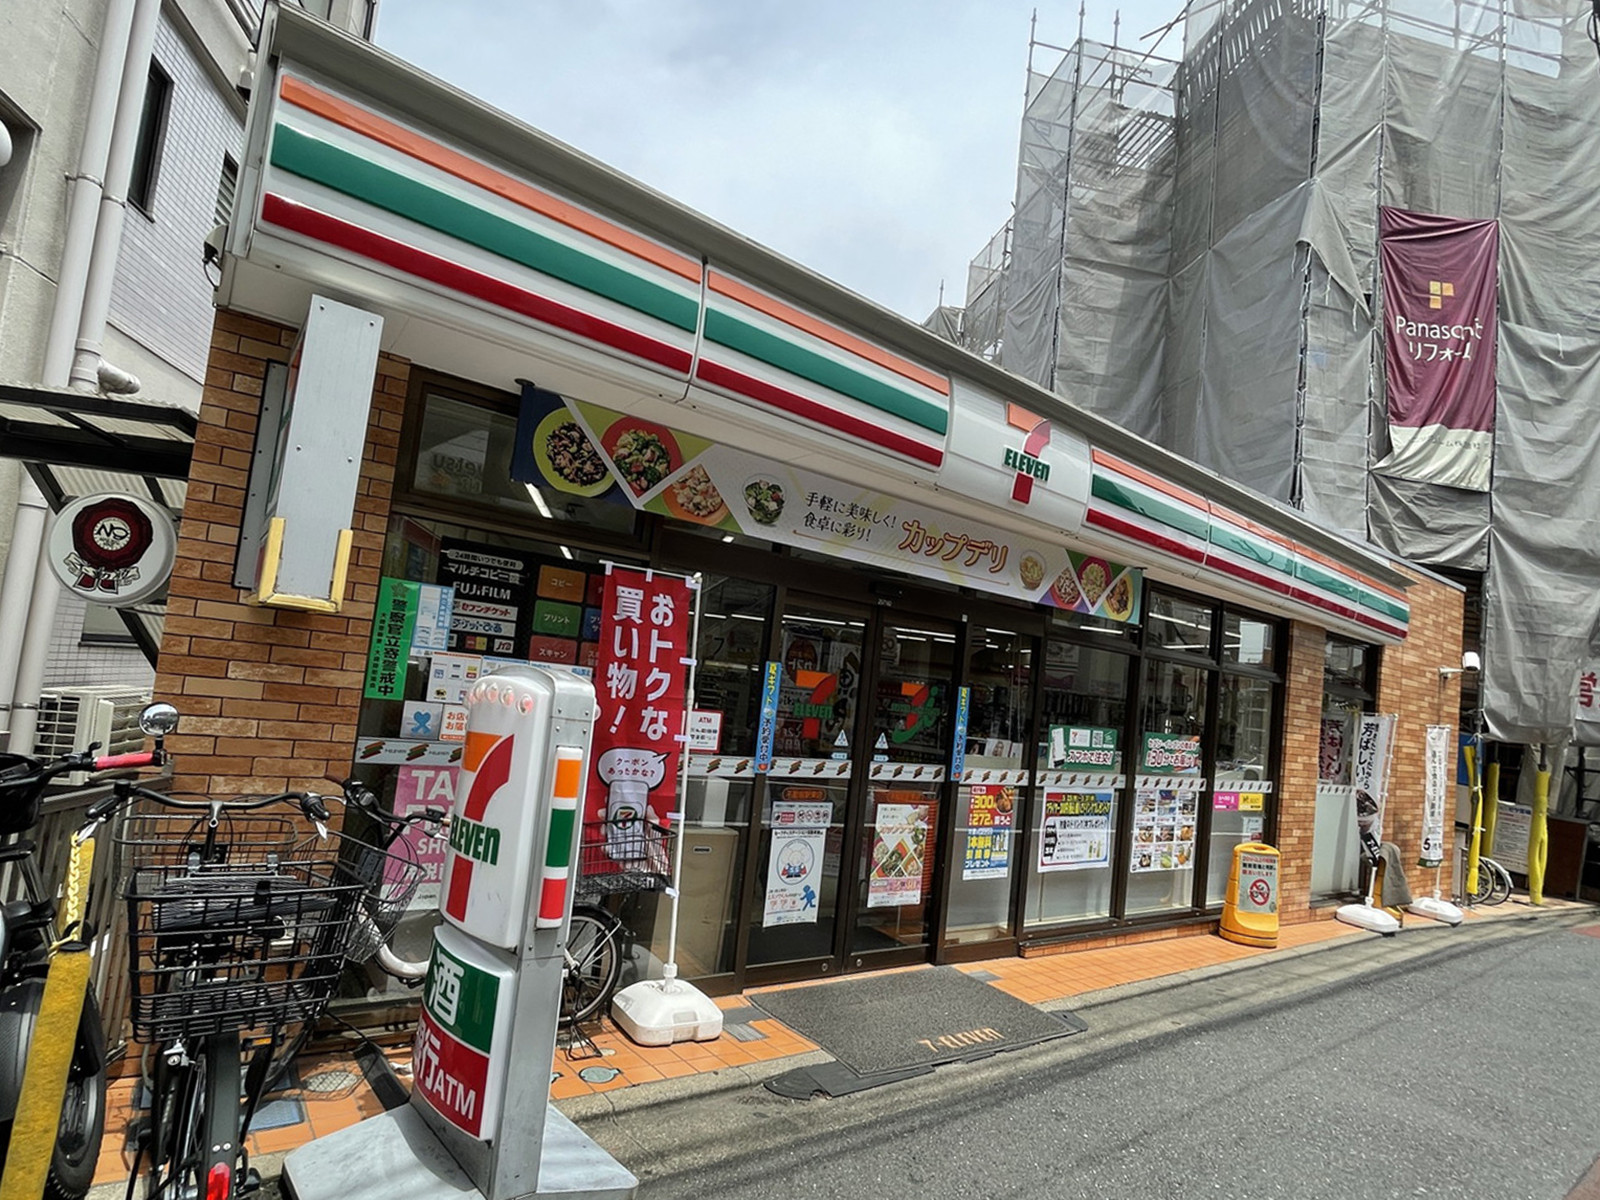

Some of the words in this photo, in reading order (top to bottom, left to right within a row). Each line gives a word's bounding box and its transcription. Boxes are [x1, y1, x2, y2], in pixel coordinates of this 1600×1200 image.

[805, 492, 897, 528] 手軽に美味しく!
[803, 513, 871, 541] 食卓に彩り!
[898, 520, 1010, 574] カップデリ
[551, 578, 573, 588] コピー
[544, 614, 571, 625] プリント
[539, 648, 568, 659] スキャン
[605, 585, 644, 734] 買い物!
[640, 593, 675, 742] おトクな
[698, 716, 712, 724] ATM
[607, 767, 655, 778] あったかな?
[616, 758, 649, 767] クーポン
[411, 770, 455, 801] TA
[428, 947, 465, 1026] 酒
